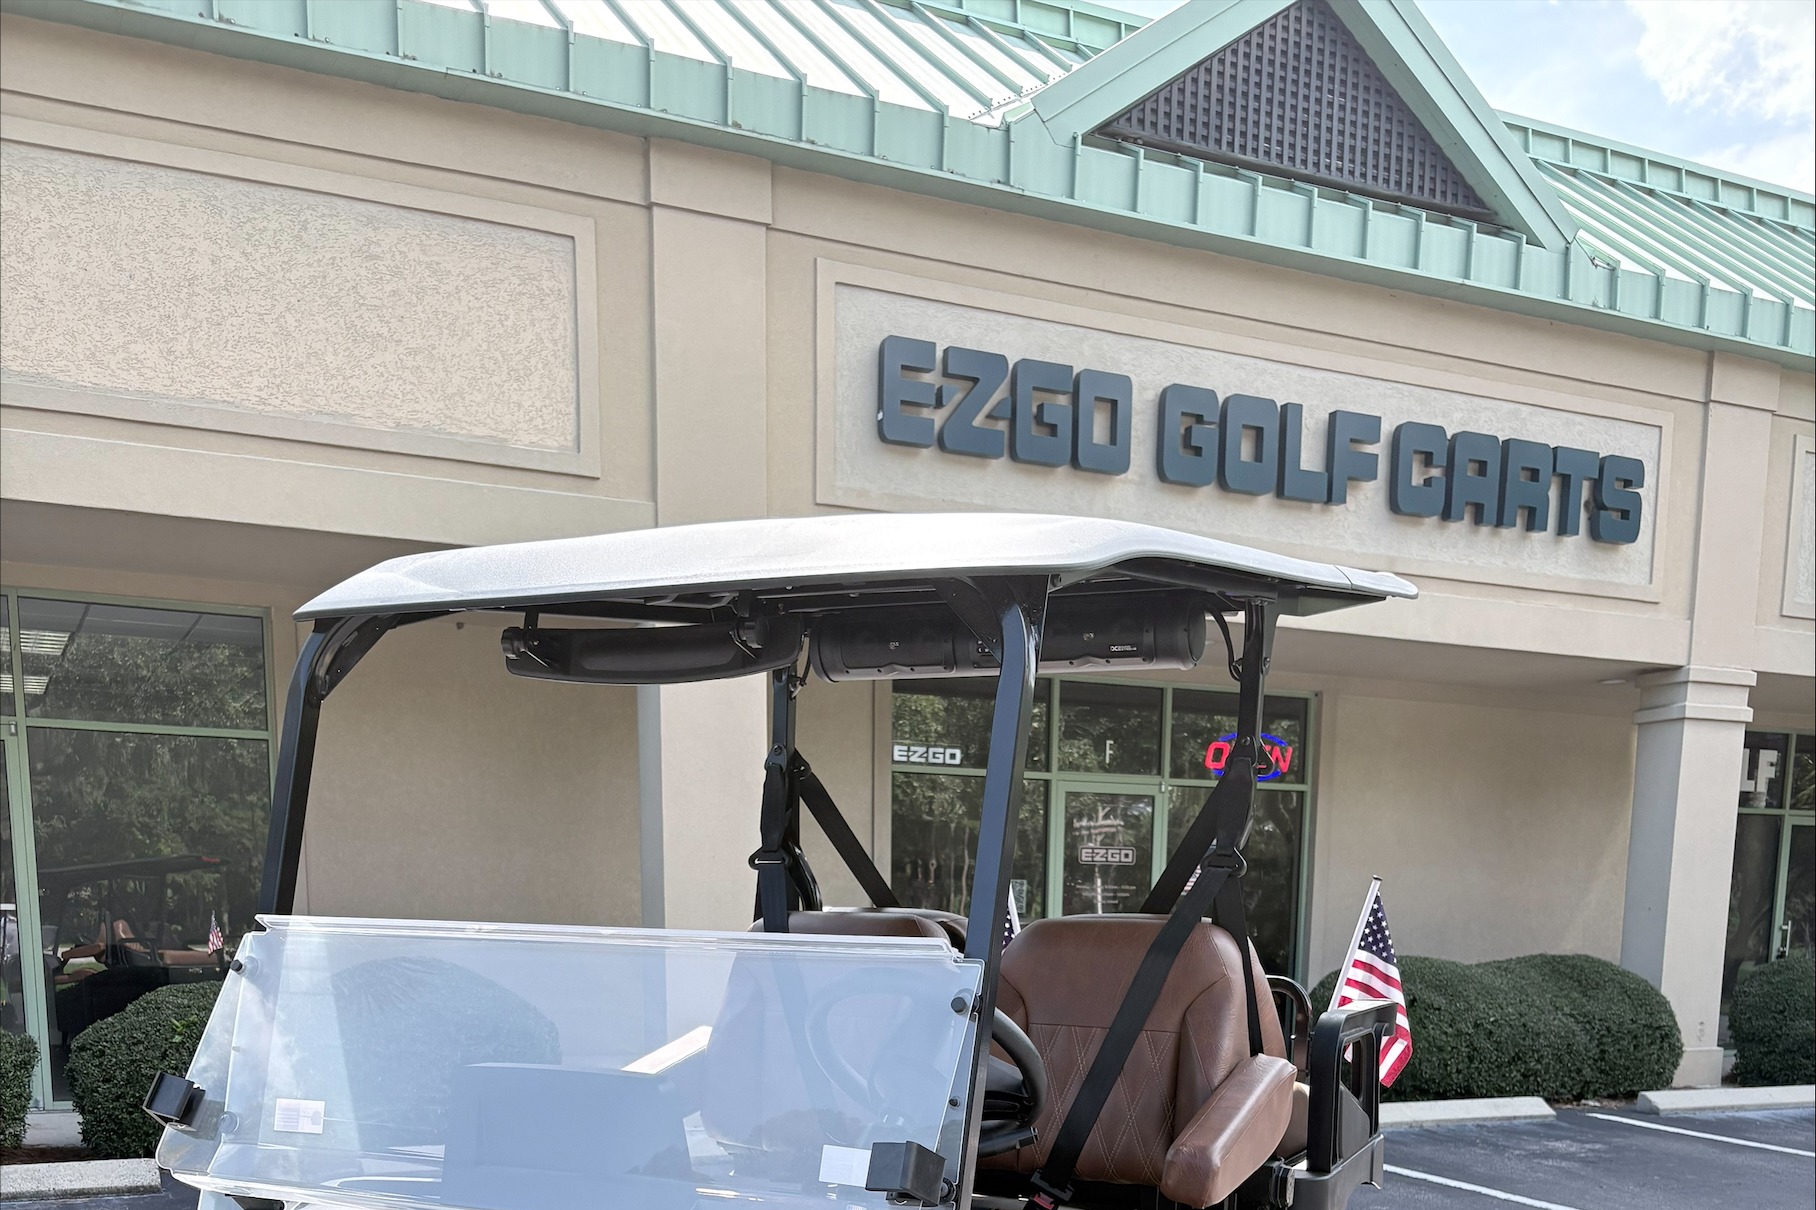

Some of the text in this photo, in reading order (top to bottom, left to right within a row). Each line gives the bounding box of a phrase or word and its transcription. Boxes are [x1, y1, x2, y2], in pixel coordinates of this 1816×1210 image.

[1157, 383, 1382, 506] GOLF
[1391, 421, 1645, 545] CARTS
[1106, 740, 1114, 764] F
[1205, 741, 1293, 773] ON
